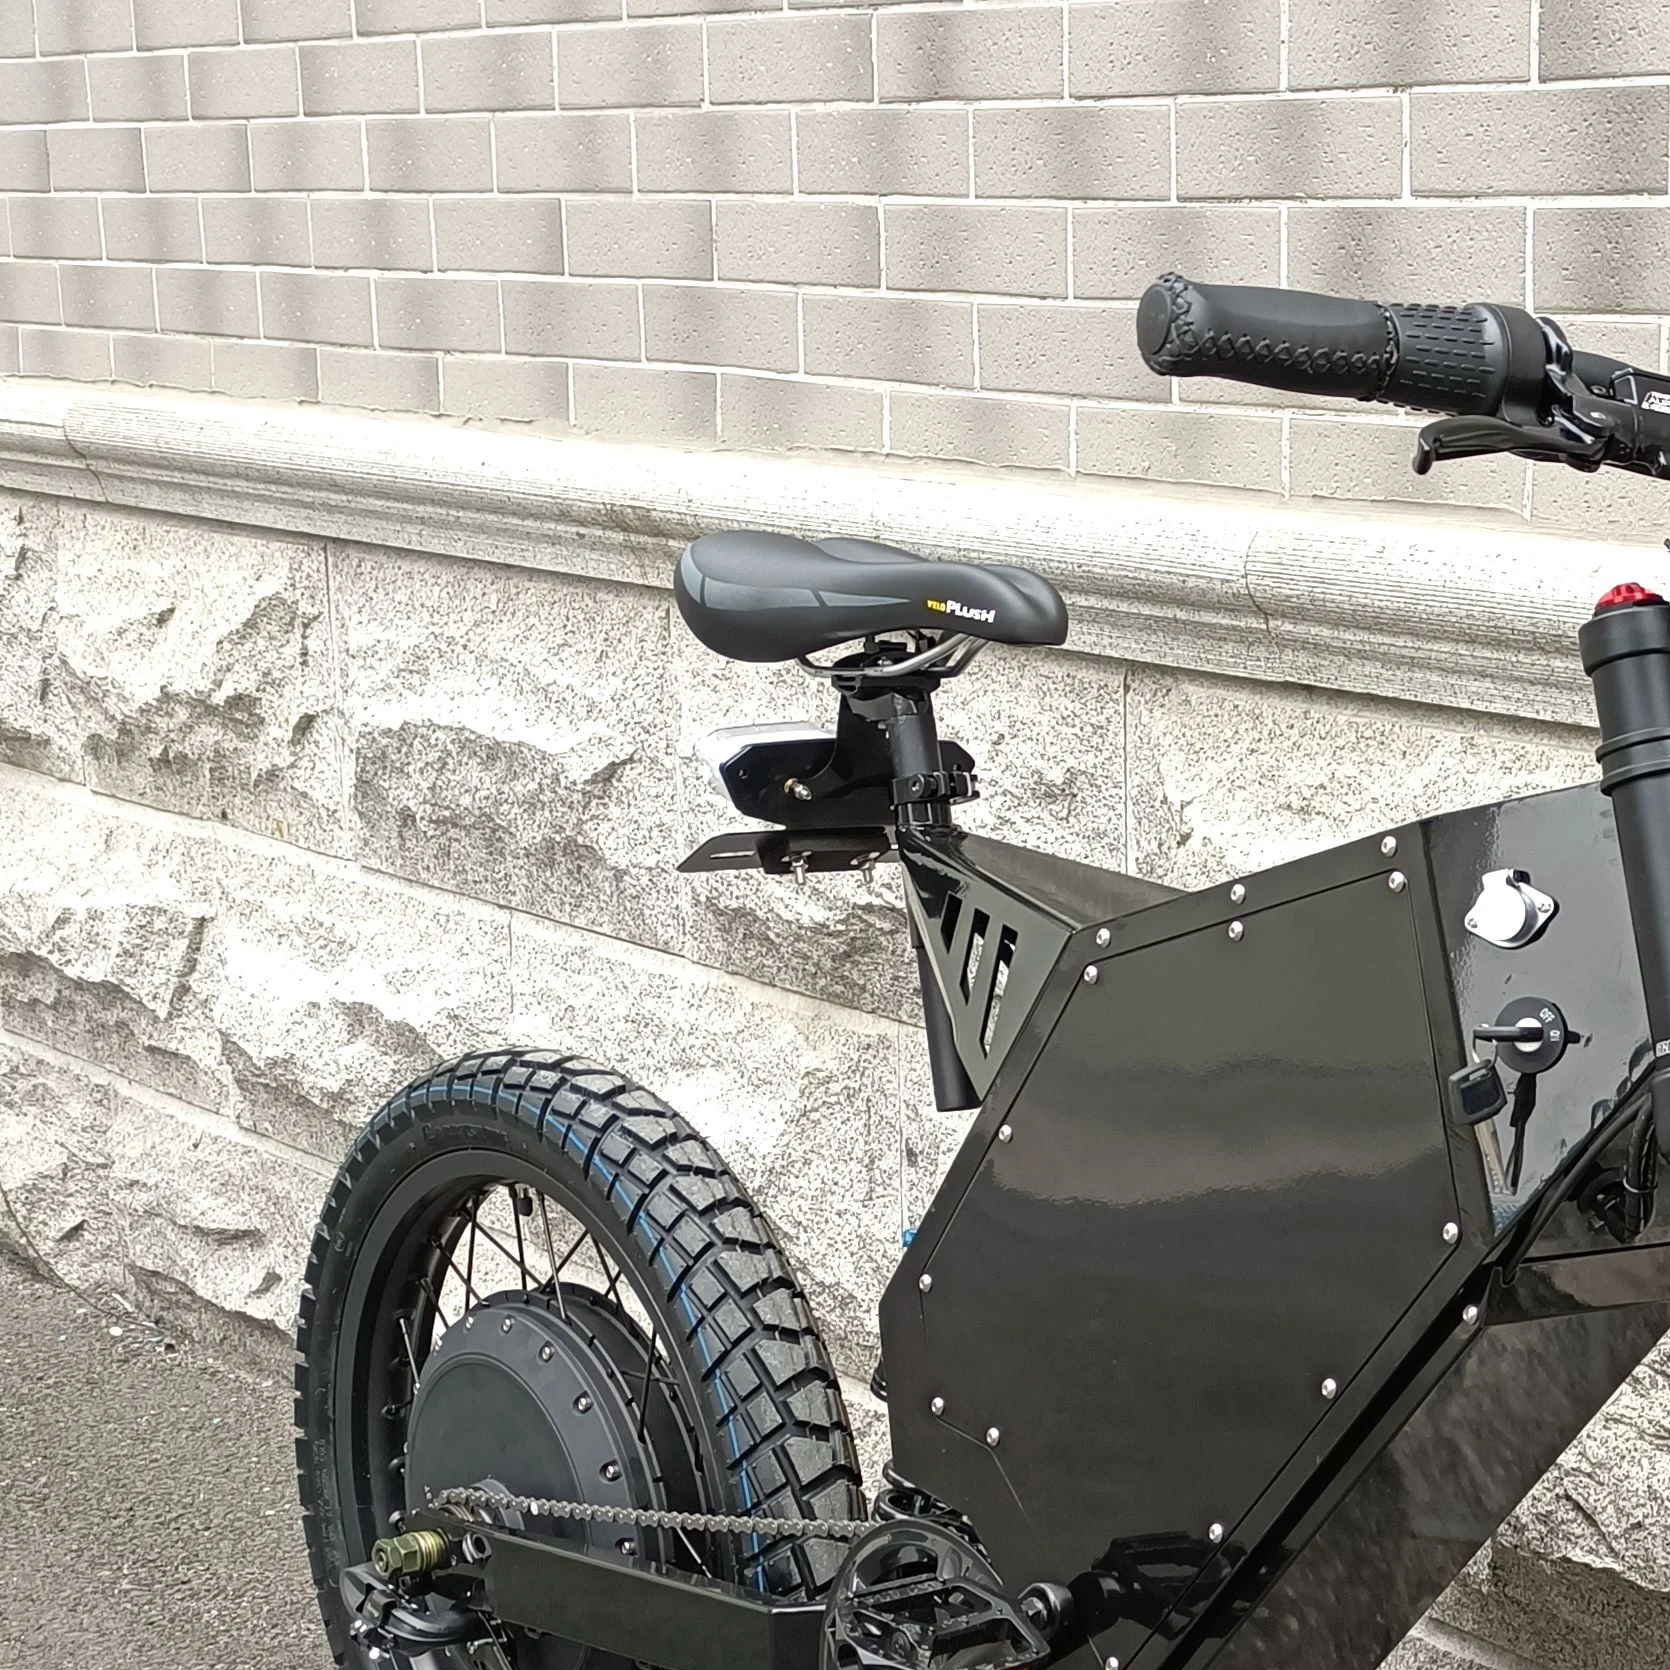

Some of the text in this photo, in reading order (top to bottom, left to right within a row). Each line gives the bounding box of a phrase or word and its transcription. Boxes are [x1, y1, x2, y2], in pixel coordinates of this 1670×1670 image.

[926, 599, 996, 623] VELO PLUSH
[1540, 1007, 1555, 1023] OFF
[1550, 1030, 1560, 1041] ON
